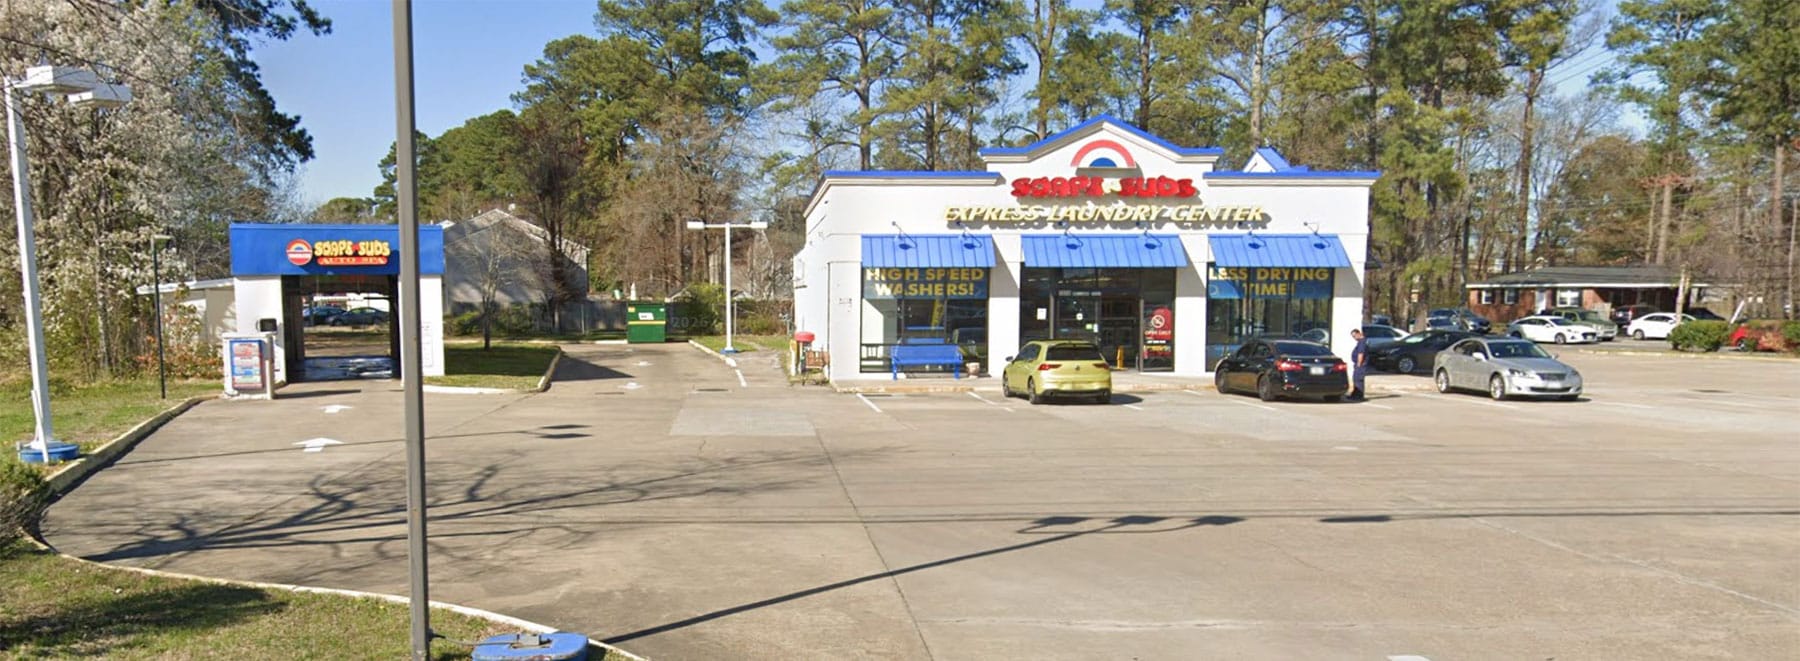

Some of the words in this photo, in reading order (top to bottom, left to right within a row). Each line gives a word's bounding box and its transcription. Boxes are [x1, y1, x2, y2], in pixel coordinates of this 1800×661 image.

[1011, 176, 1104, 198] SOAPS
[1119, 176, 1197, 198] SUDS
[944, 205, 1042, 221] EXPRESS
[1047, 205, 1165, 221] LAUNDRY
[1170, 205, 1265, 221] CENTER
[314, 240, 353, 256] SOAPS
[358, 240, 391, 256] SUDS
[865, 267, 920, 281] HIGH
[925, 267, 985, 281] SPEED
[1208, 266, 1248, 280] LESS
[1256, 268, 1329, 280] DRYING
[874, 283, 975, 296] WASHERS!
